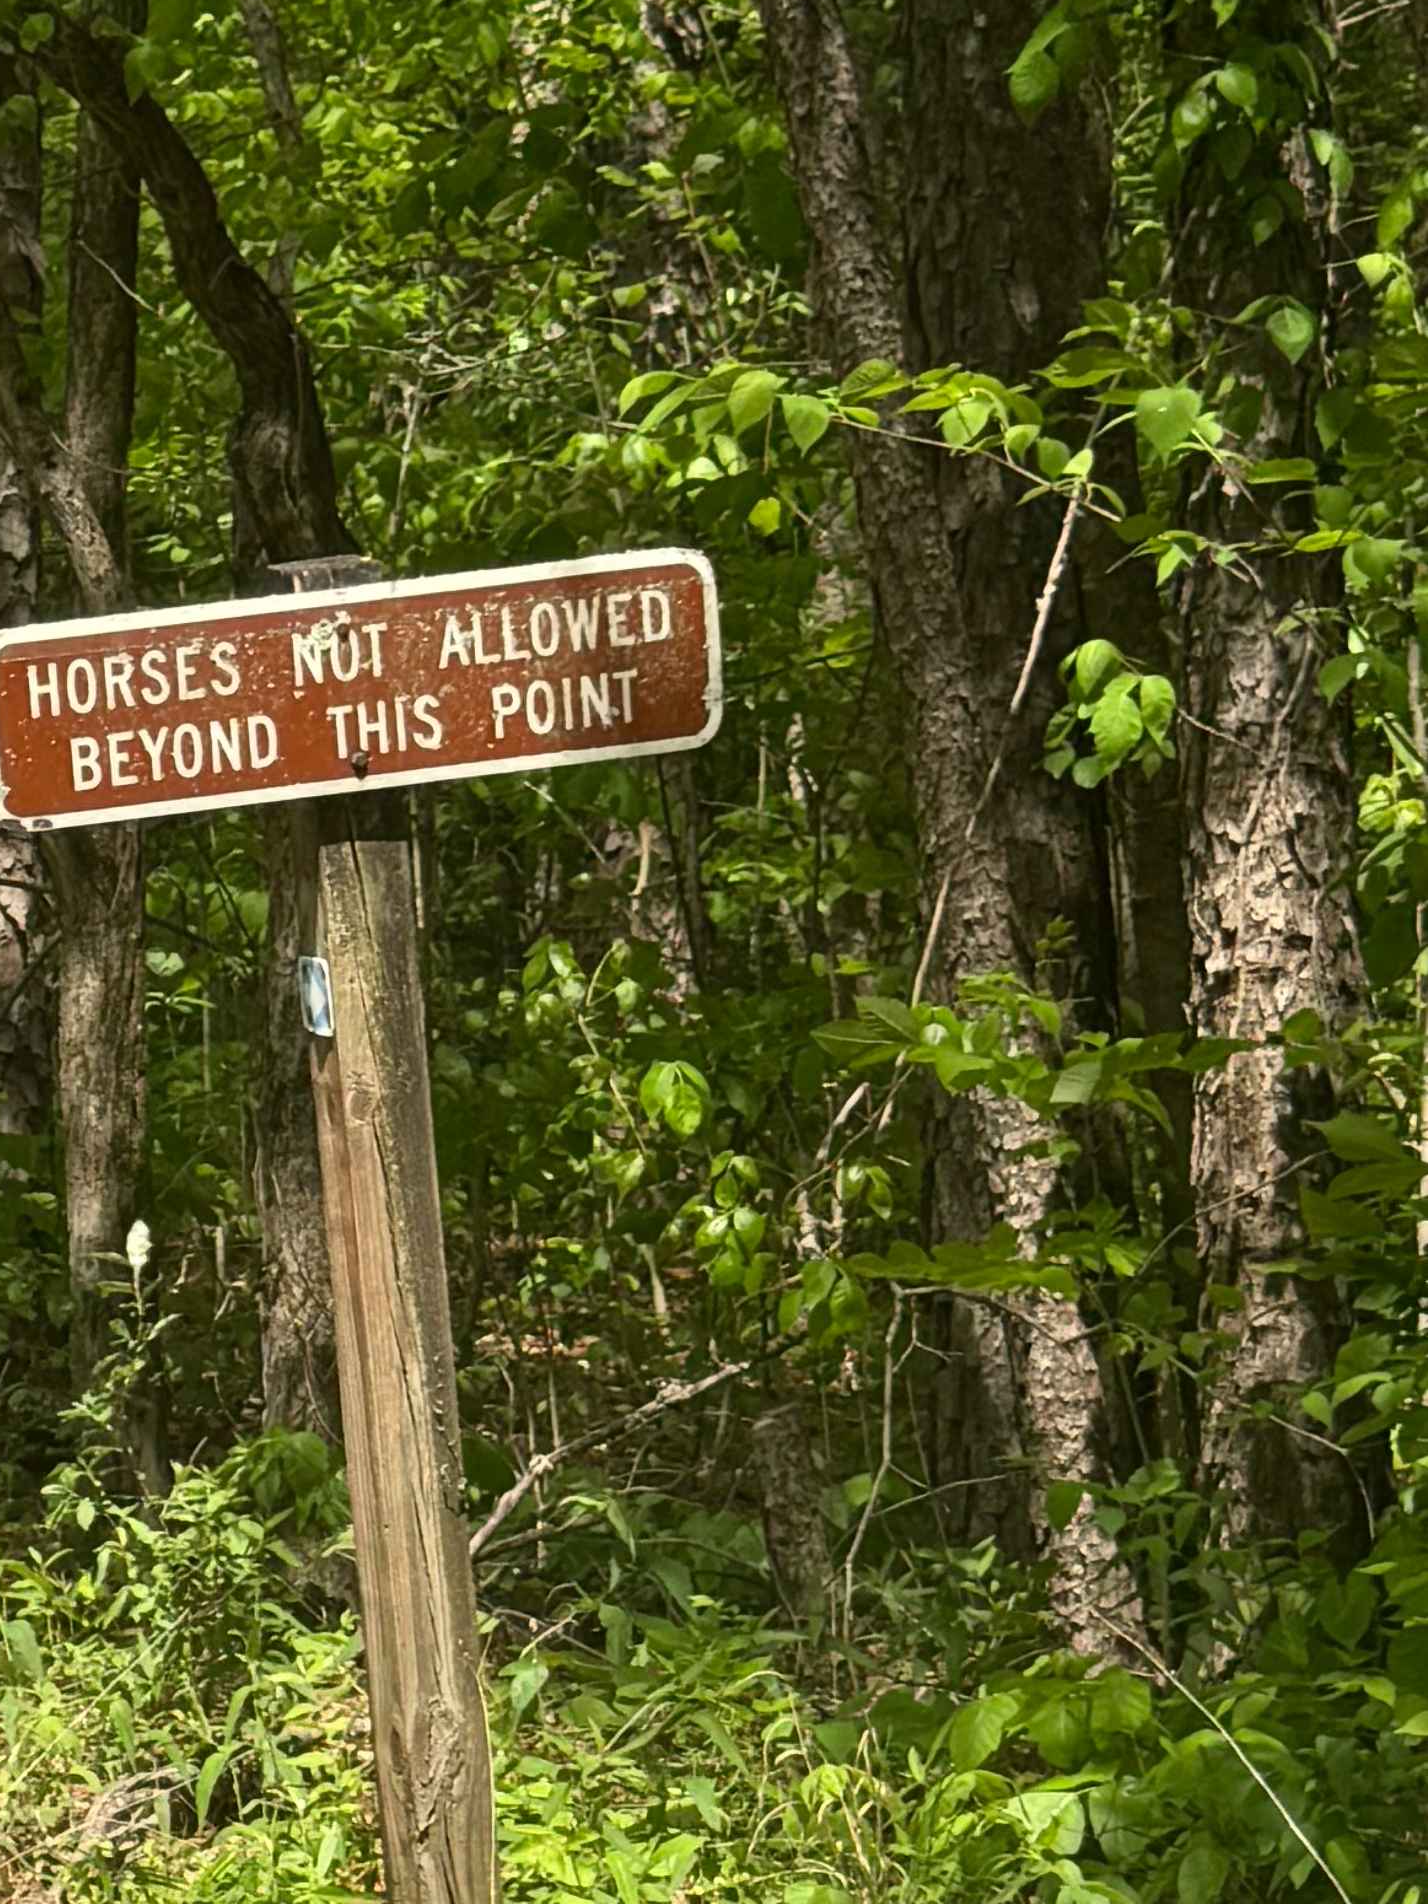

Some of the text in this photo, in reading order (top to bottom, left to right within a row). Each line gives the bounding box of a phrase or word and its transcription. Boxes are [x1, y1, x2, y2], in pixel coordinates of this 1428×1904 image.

[28, 590, 671, 718] HORSES NOT ALLOWED
[70, 670, 638, 793] BEYOND THIS POINT
